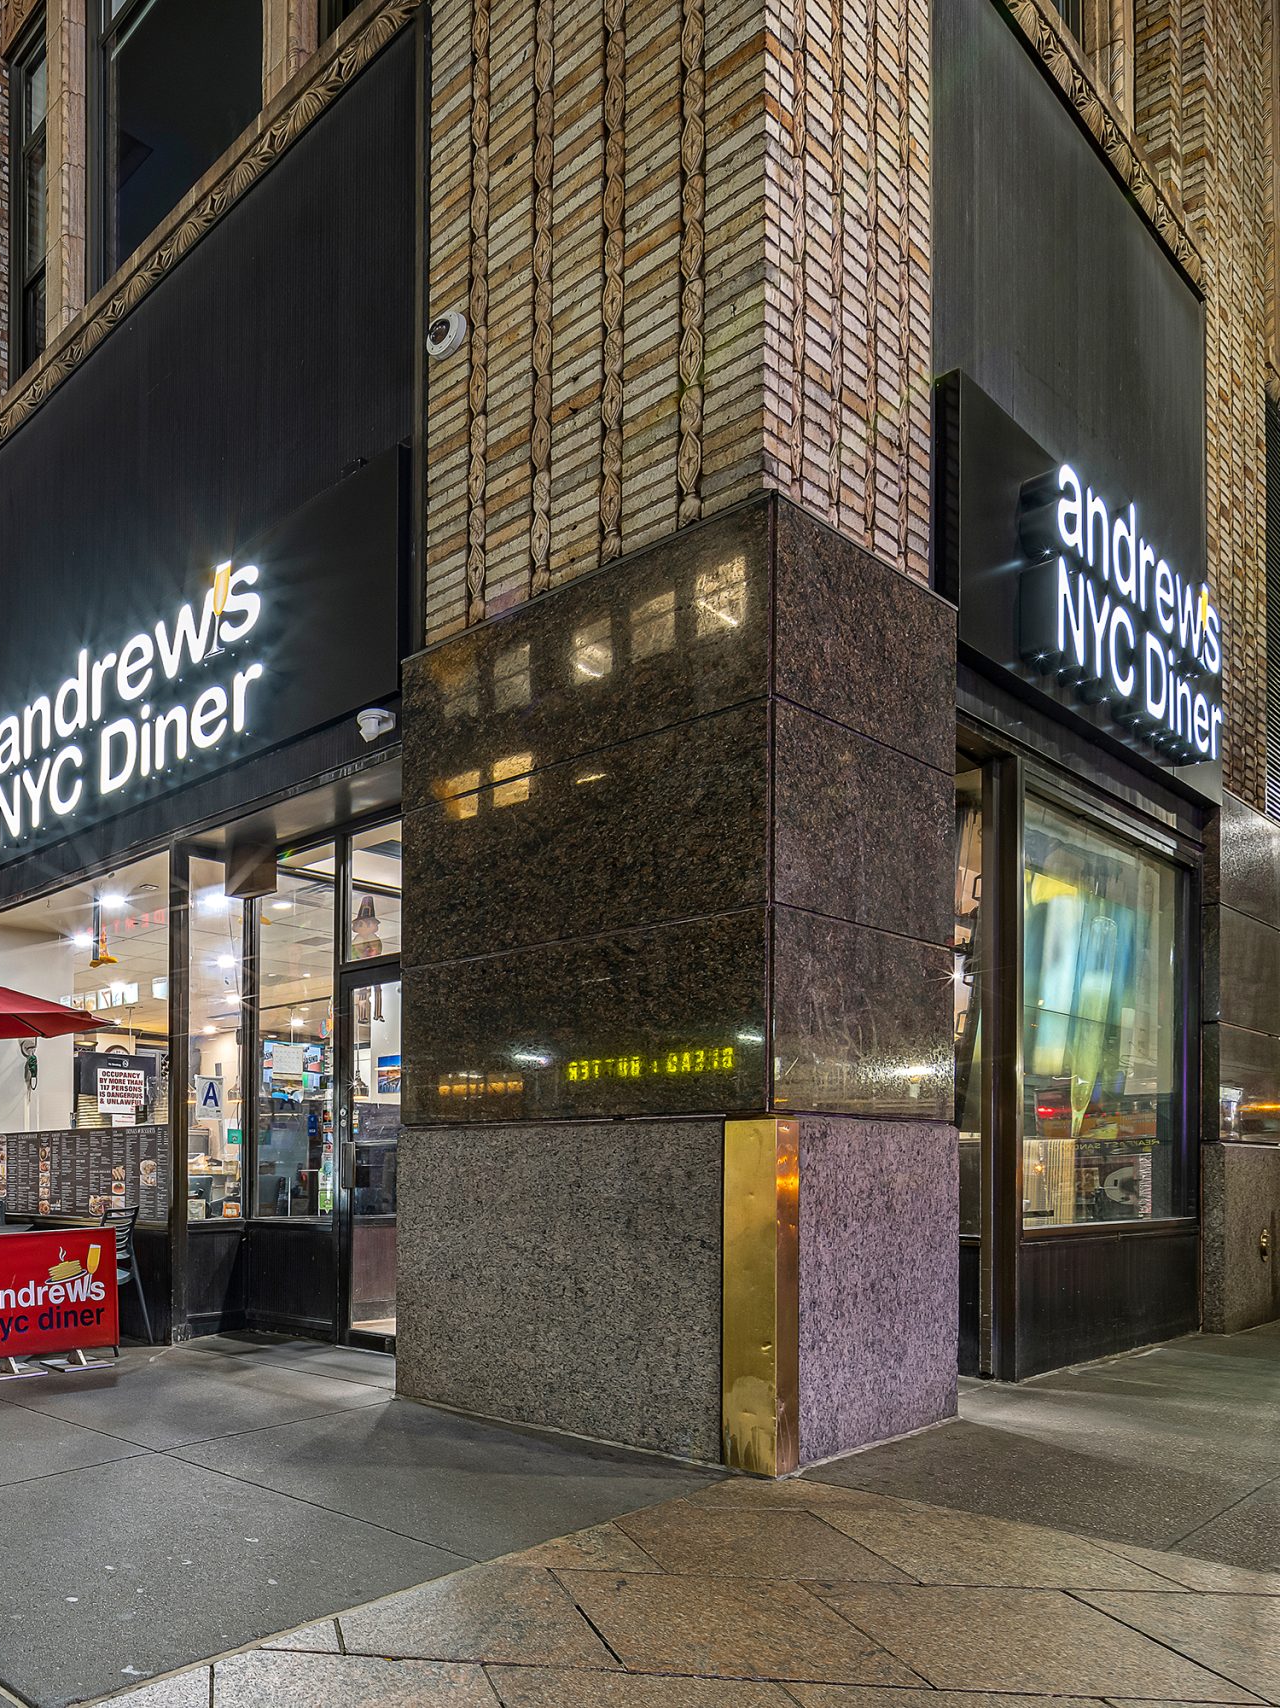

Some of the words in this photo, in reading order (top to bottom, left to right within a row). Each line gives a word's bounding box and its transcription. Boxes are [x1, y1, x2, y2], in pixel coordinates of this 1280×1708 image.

[1058, 556, 1135, 697] NYC
[1146, 631, 1222, 760] Diner
[100, 663, 263, 795] Diner
[101, 1070, 141, 1078] OCCUPANCY
[106, 1098, 143, 1106] UNLAWFUL
[202, 1081, 219, 1107] A
[38, 1306, 105, 1331] diner
